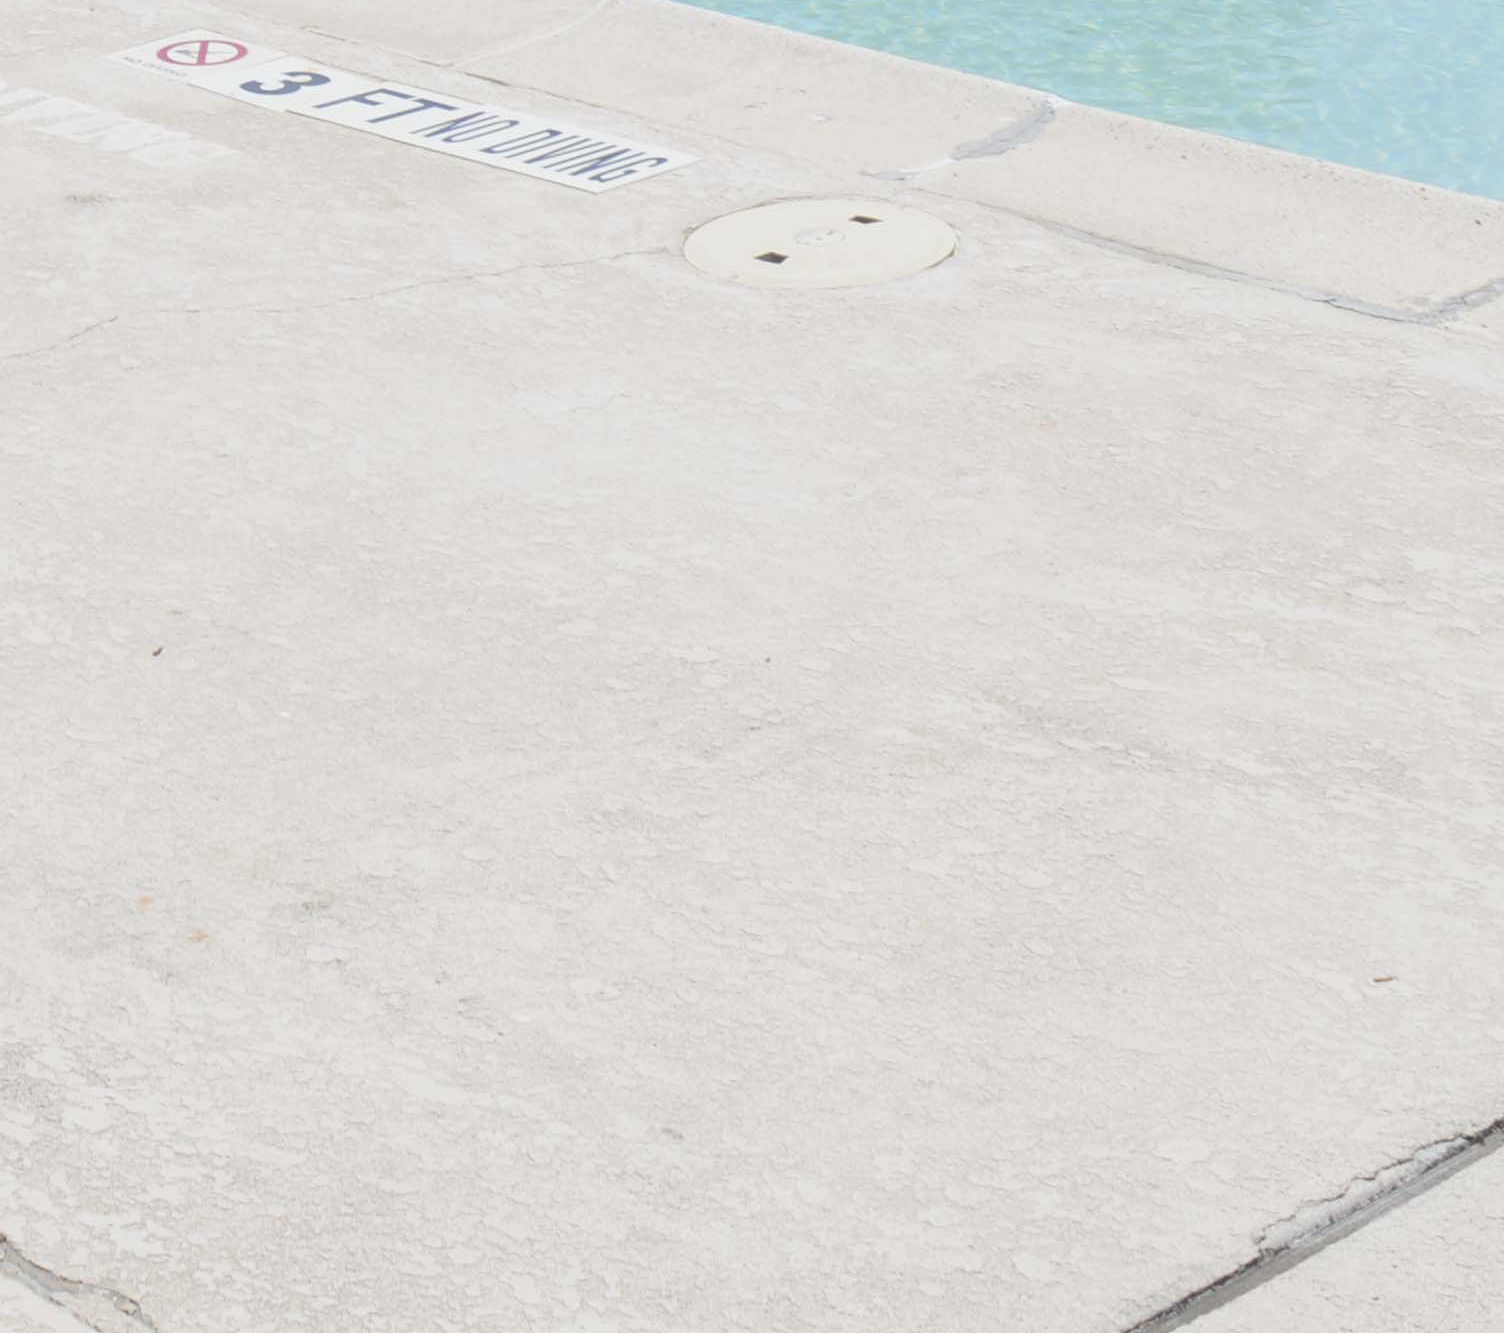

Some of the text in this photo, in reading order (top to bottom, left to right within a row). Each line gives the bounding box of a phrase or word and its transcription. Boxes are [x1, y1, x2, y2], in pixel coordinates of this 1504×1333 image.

[238, 69, 669, 183] 3 FT NO DIVING
